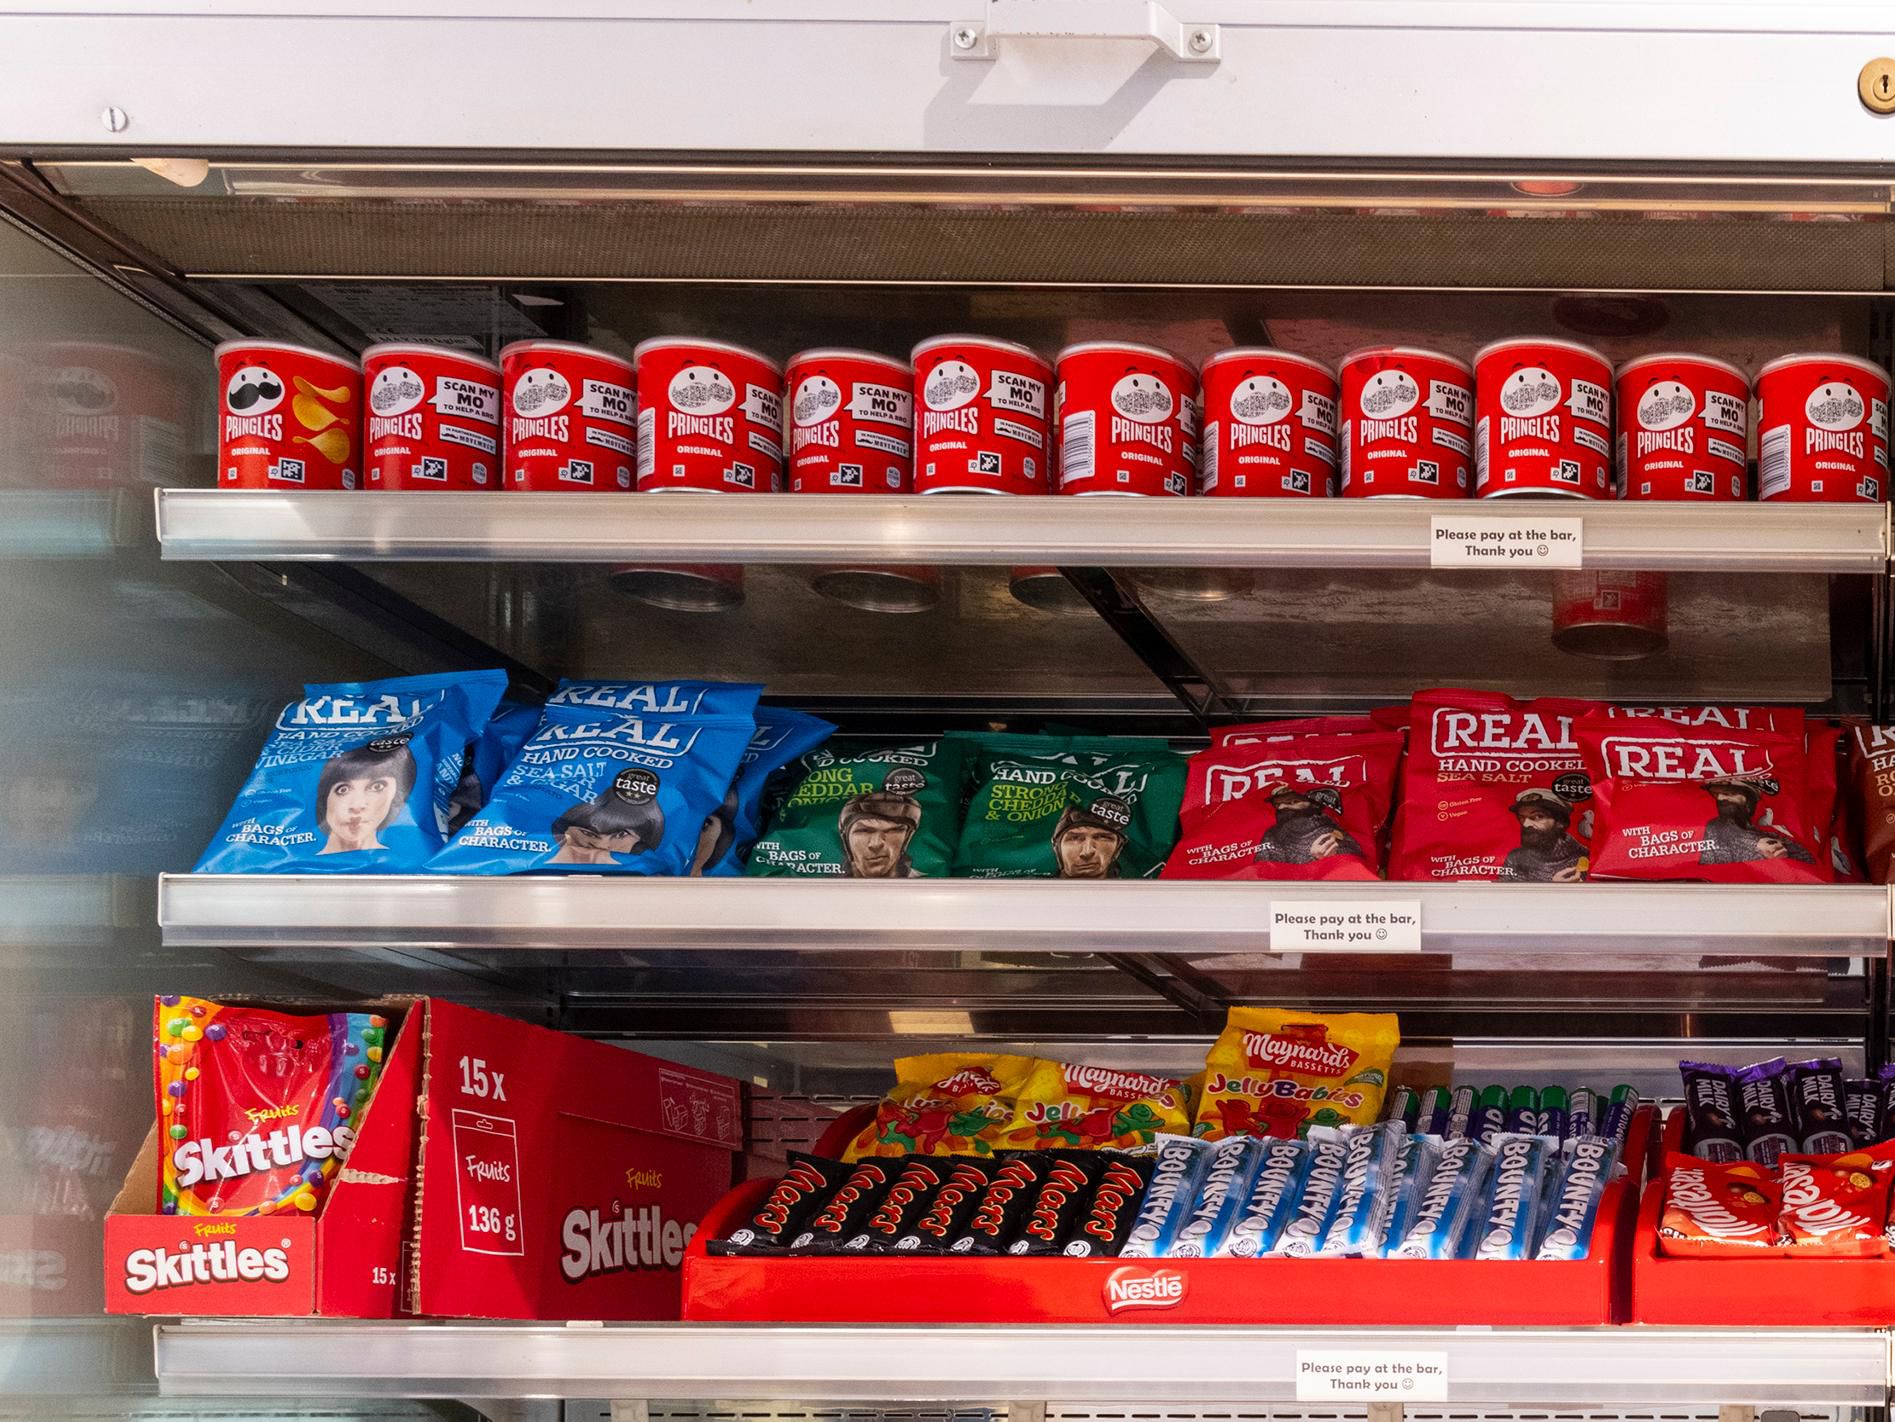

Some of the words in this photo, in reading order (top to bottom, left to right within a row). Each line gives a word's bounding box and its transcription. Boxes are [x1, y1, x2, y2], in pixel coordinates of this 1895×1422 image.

[444, 381, 477, 394] SCAN
[479, 387, 494, 399] MY
[456, 406, 473, 414] HELP
[458, 393, 484, 408] MO
[226, 413, 283, 443] PRINGLES
[370, 413, 422, 444] PRINGLES
[924, 407, 978, 438] PRINGLES
[231, 447, 271, 457] ORIGINAL
[375, 447, 411, 457] ORIGINAL
[929, 441, 967, 452] ORIGINAL
[1806, 428, 1864, 460] PRINGLES
[1815, 461, 1856, 472] ORIGINAL
[1435, 529, 1477, 542] Please
[1481, 532, 1505, 544] pay
[1508, 530, 1523, 542] at
[1526, 528, 1547, 542] the
[1550, 529, 1577, 544] bar,
[1464, 544, 1506, 557] Thank
[1509, 548, 1534, 558] you
[552, 685, 690, 712] REAL
[521, 747, 580, 764] HAND
[584, 747, 673, 769] COOKED
[1613, 744, 1765, 781] REAL
[616, 777, 657, 795] taste
[1437, 772, 1476, 782] SEA
[1481, 773, 1532, 783] SALT
[459, 836, 552, 852] CHARACTER.
[1275, 913, 1316, 924] Please
[1320, 916, 1344, 926] pay
[1348, 914, 1362, 924] at
[1366, 913, 1386, 924] the
[1390, 913, 1416, 926] bar,
[1303, 929, 1345, 940] Thank
[1348, 932, 1372, 942] you
[1242, 1032, 1352, 1070] Maynards
[1290, 1059, 1342, 1076] BASSETTS
[459, 1055, 488, 1097] 15
[492, 1072, 506, 1102] x
[1802, 1076, 1818, 1105] MILK
[1817, 1075, 1836, 1112] DAIRY
[174, 1125, 356, 1187] Skittles
[466, 1154, 511, 1183] Fruits
[1150, 1145, 1193, 1224] BOUNTY
[1084, 1162, 1144, 1241] Mars
[469, 1205, 501, 1234] 136
[505, 1214, 516, 1242] g
[126, 1240, 289, 1291] Skittles
[1302, 1362, 1343, 1374] Please
[1347, 1366, 1371, 1376] pay
[1374, 1364, 1389, 1374] at
[1392, 1363, 1413, 1374] the
[1416, 1363, 1443, 1376] bar,
[1330, 1379, 1371, 1390] Thank
[1375, 1382, 1398, 1392] you
